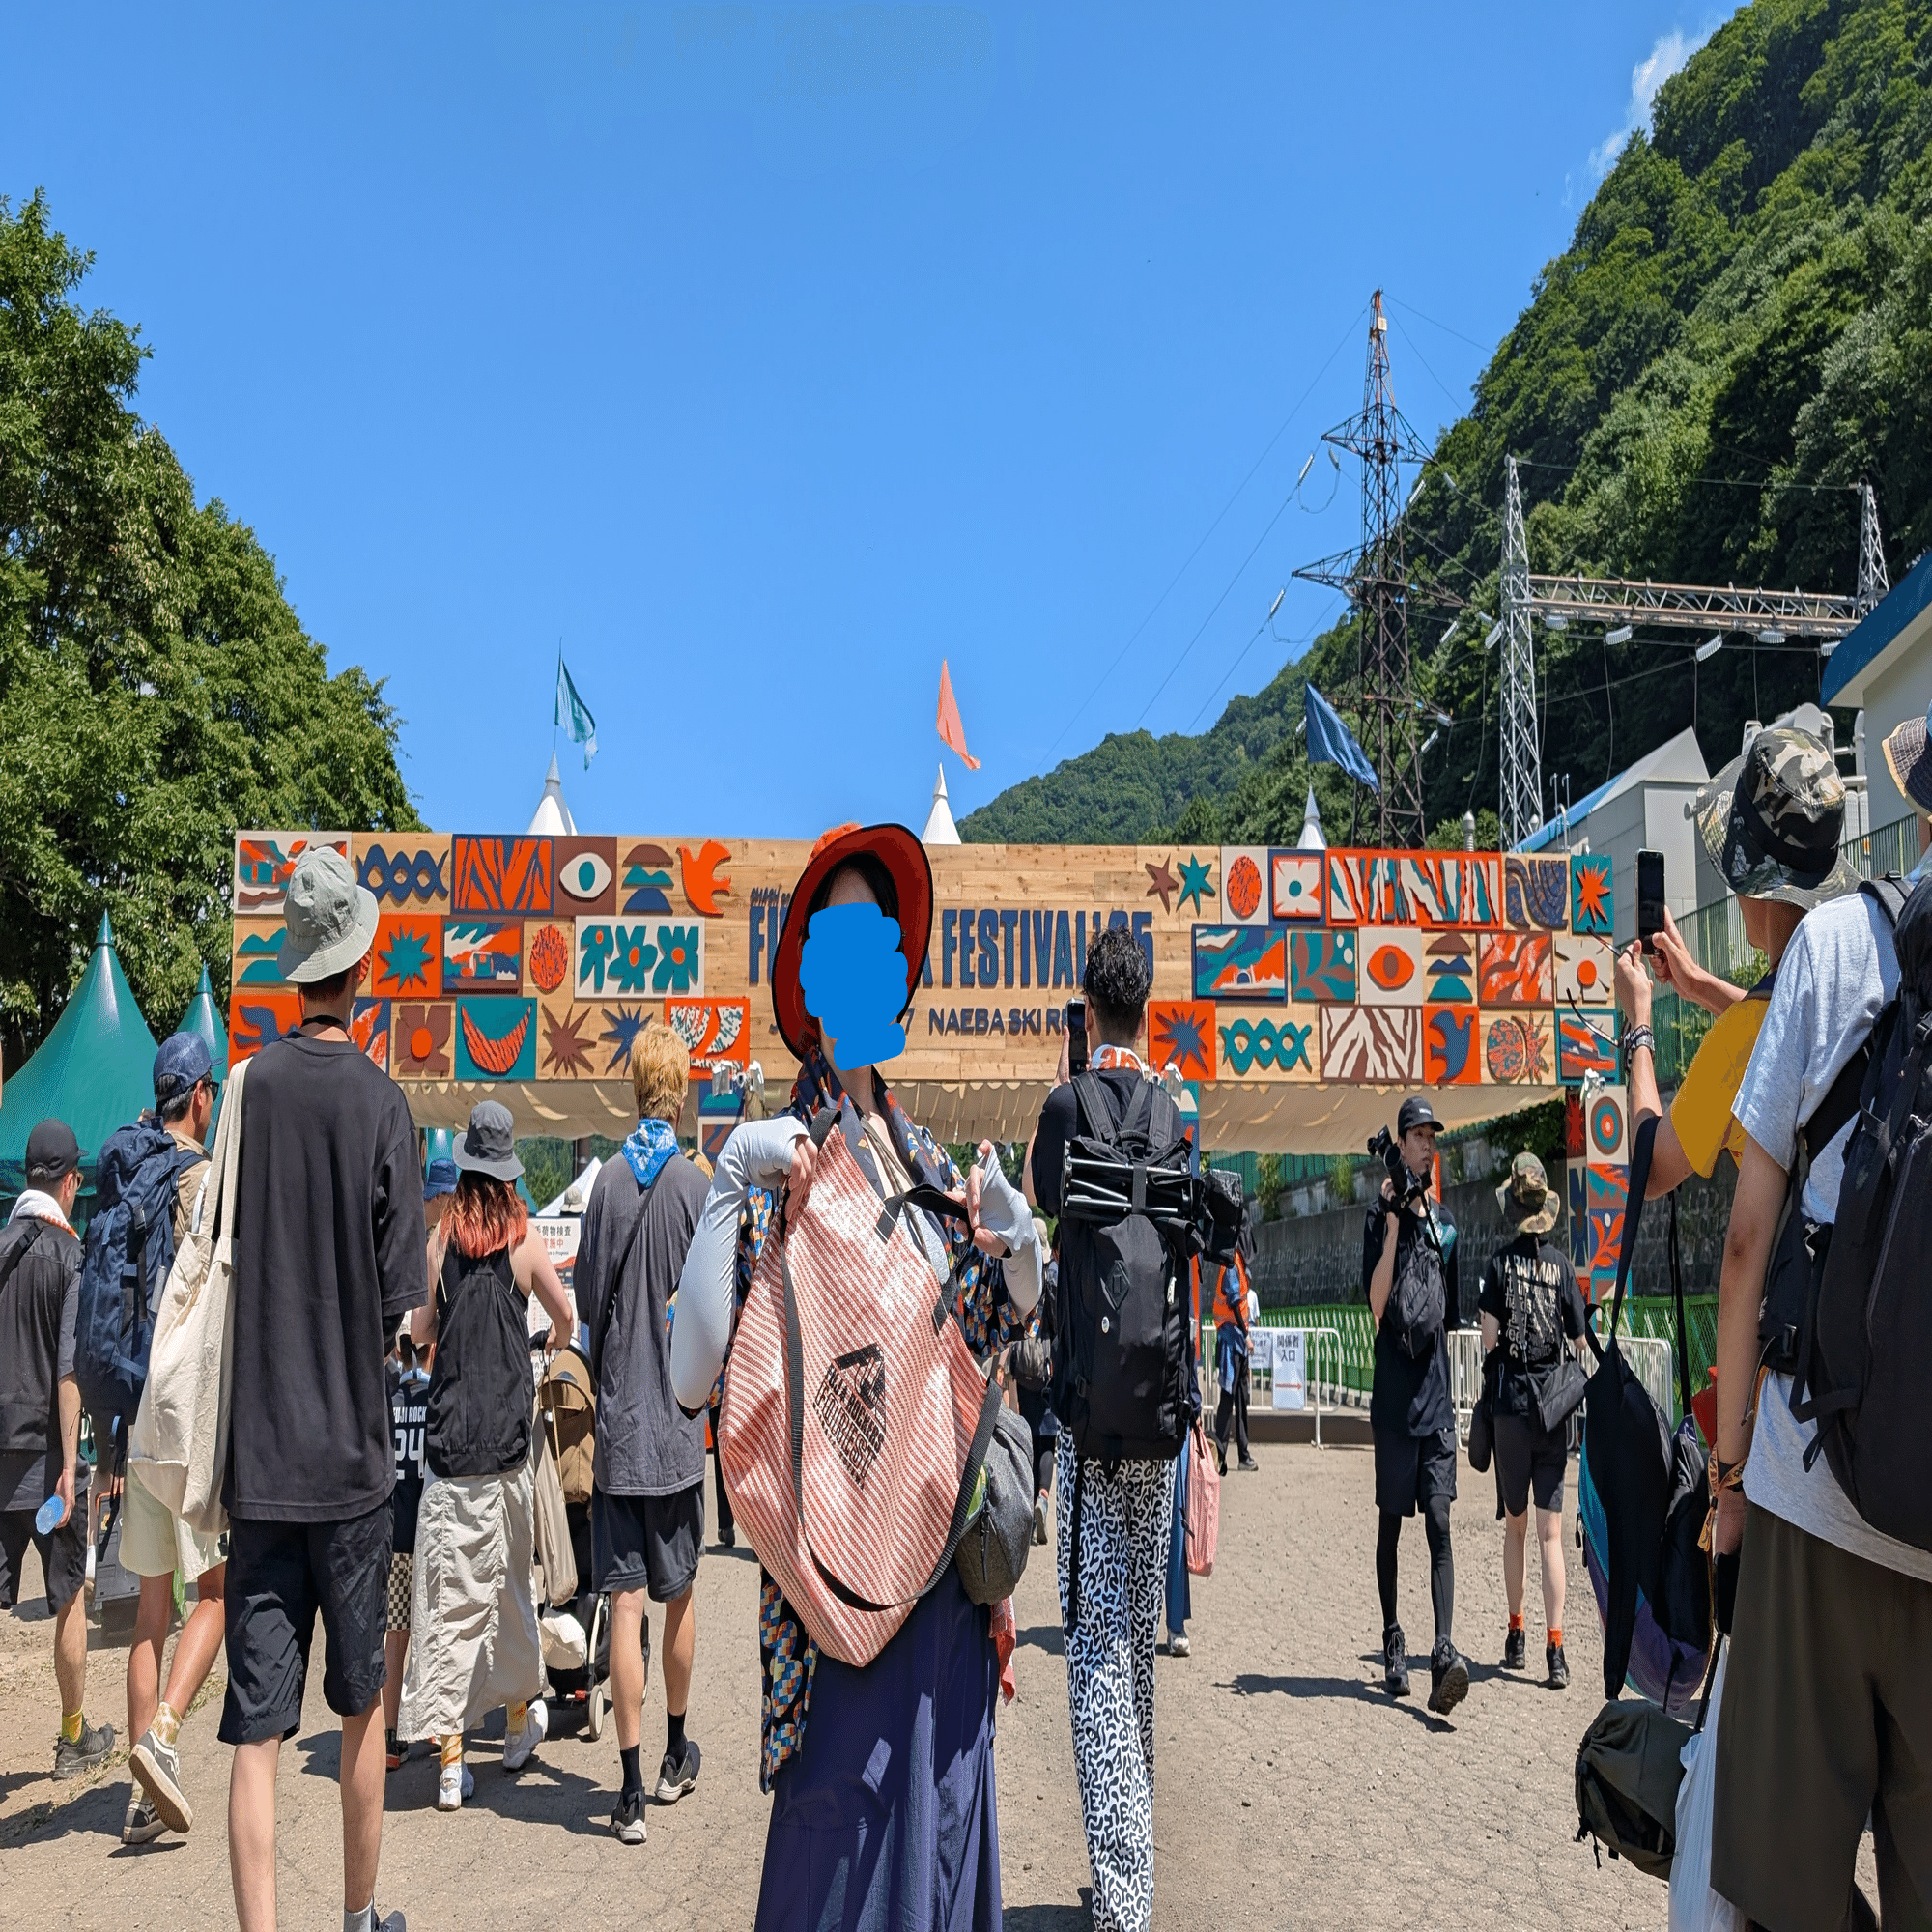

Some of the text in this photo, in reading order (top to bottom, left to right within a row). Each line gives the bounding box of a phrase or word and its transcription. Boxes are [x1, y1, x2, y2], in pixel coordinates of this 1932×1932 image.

[929, 1008, 1005, 1037] NAEBA
[1008, 1008, 1041, 1037] SKI
[1281, 1350, 1295, 1362] 入口
[408, 1406, 427, 1423] ROCK
[814, 1380, 878, 1480] FOREST
[395, 1428, 425, 1480] 24
